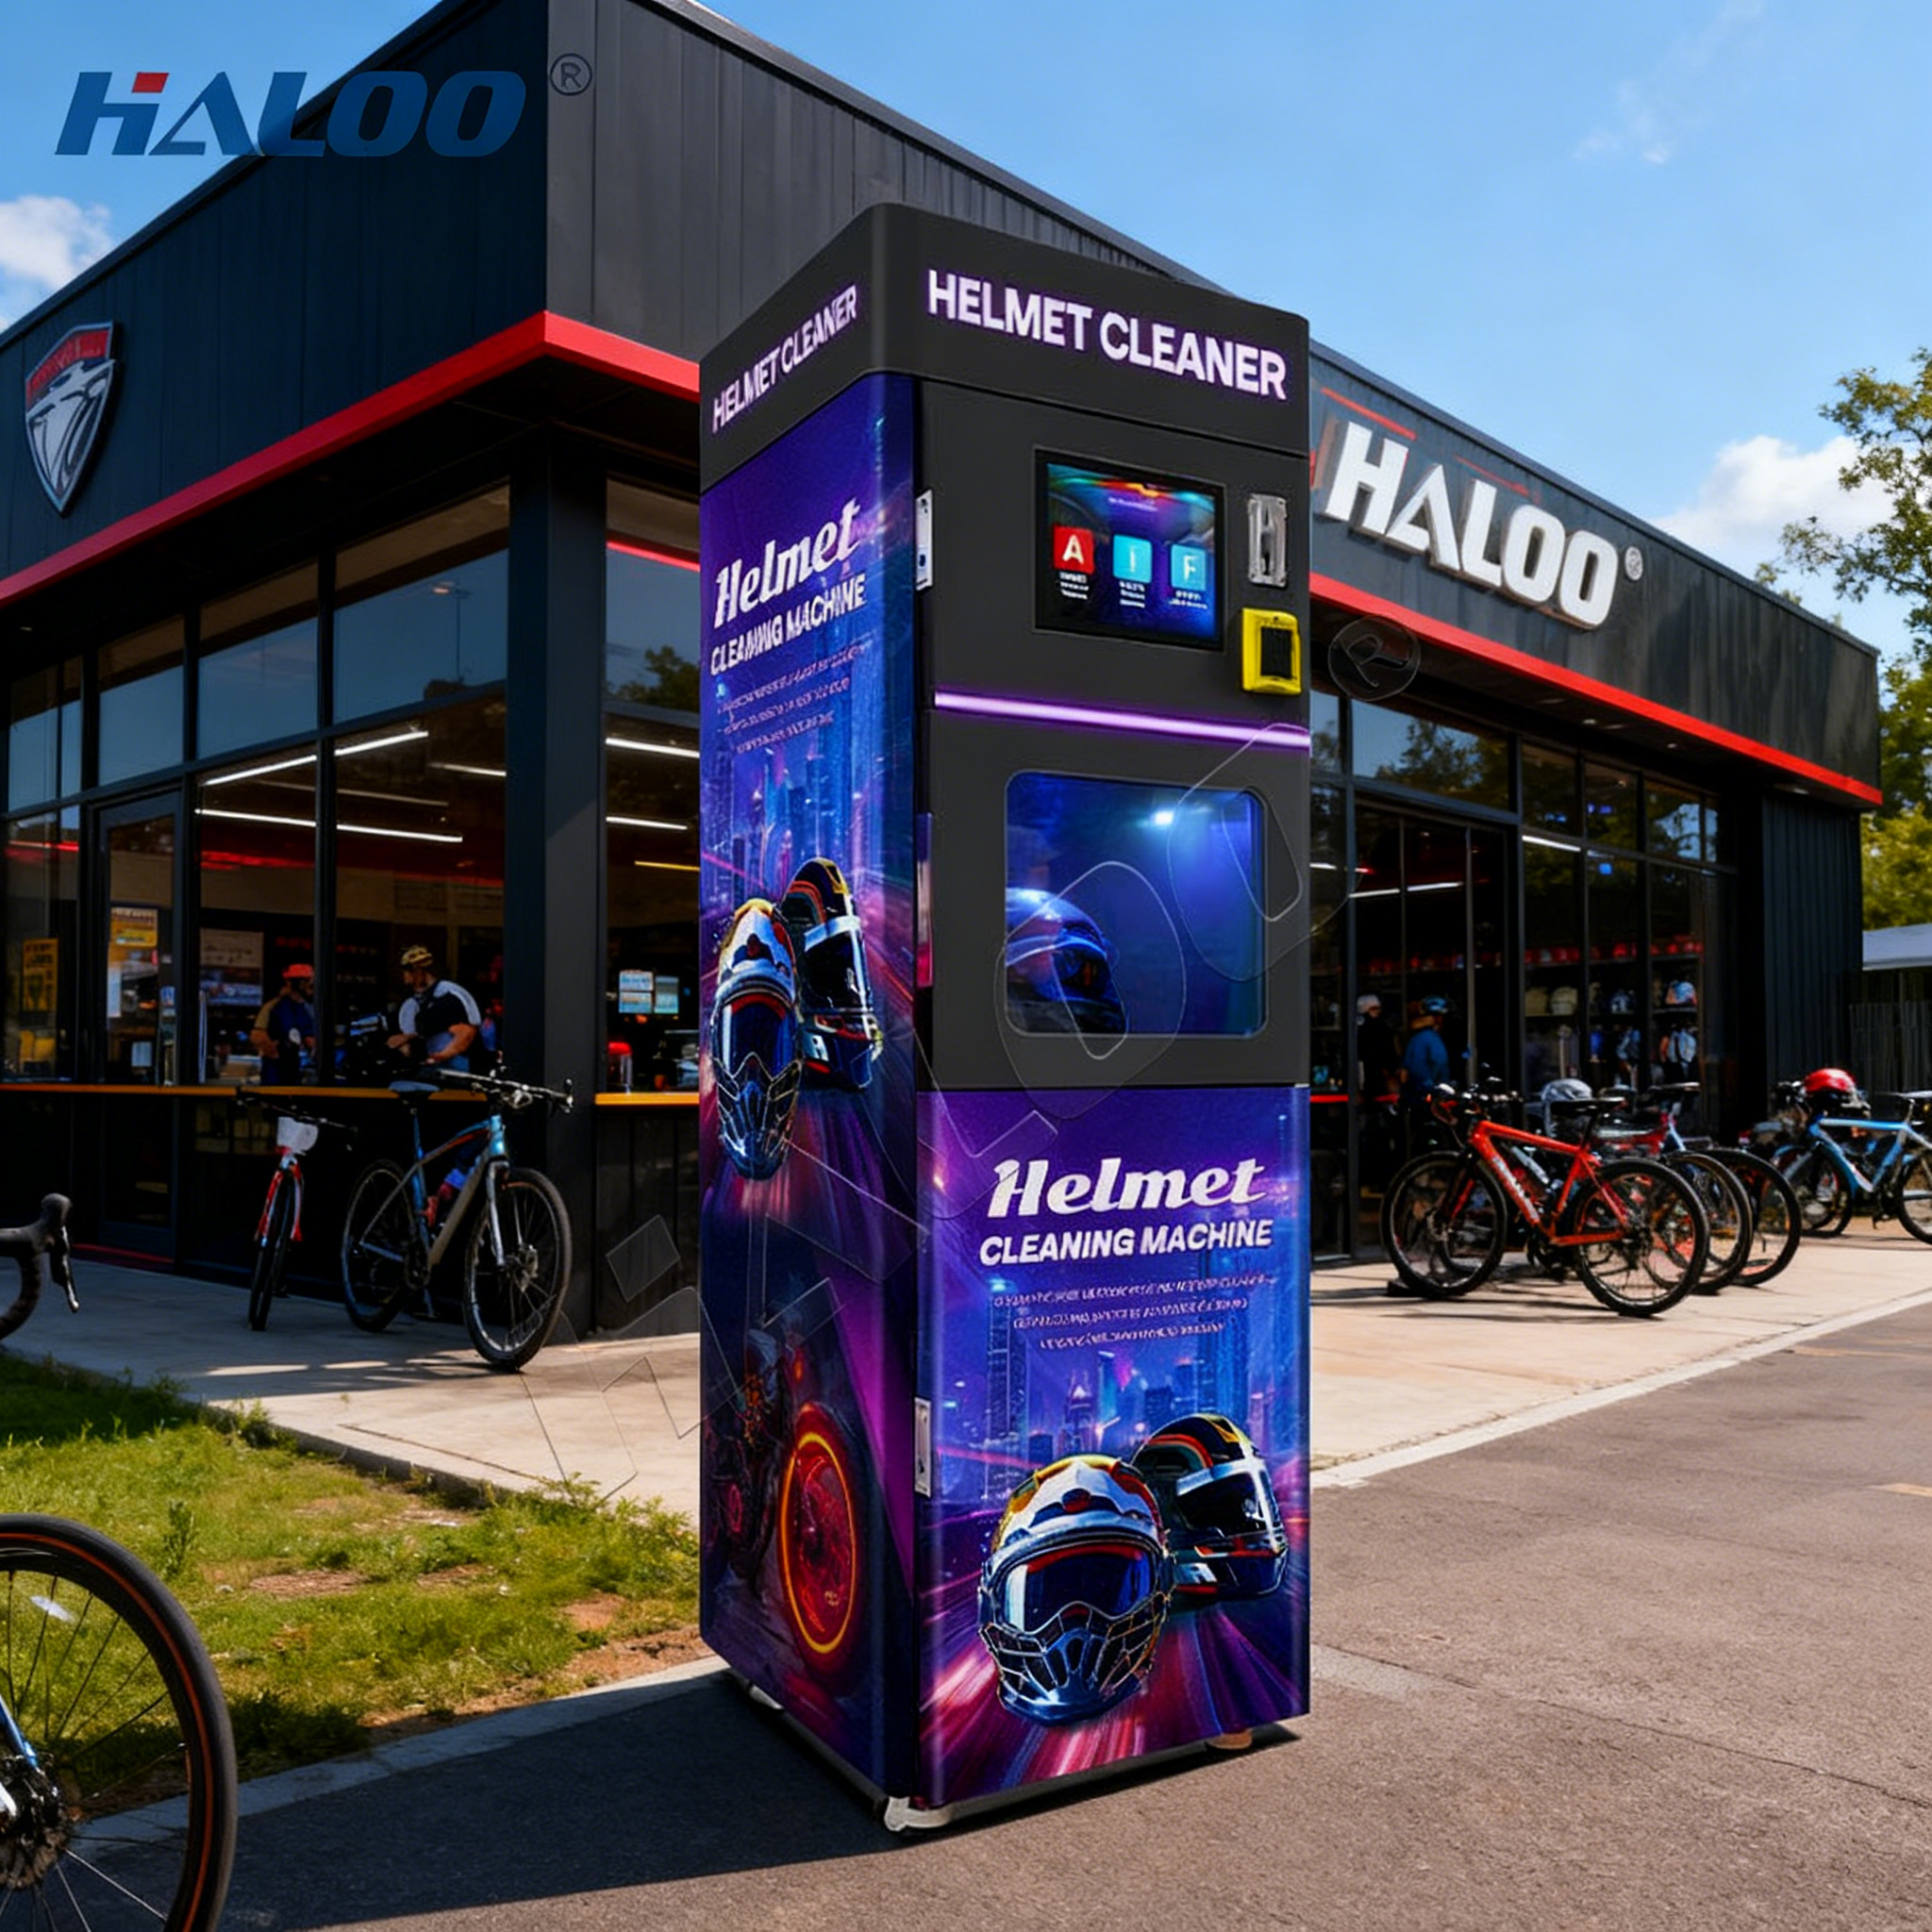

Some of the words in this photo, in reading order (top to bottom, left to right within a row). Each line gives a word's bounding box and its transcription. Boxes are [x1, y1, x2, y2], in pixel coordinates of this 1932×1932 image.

[712, 347, 780, 433] HELMET
[781, 285, 857, 374] CLEANER
[928, 269, 1092, 350] HELMET
[1100, 311, 1286, 400] CLEANER
[713, 497, 861, 629] Helmet
[1324, 421, 1619, 626] HALOO
[786, 573, 867, 642] MACHINE
[979, 1227, 1136, 1265] CLEANING
[1140, 1219, 1273, 1255] MACHINE
[987, 1158, 1267, 1218] Helmet
